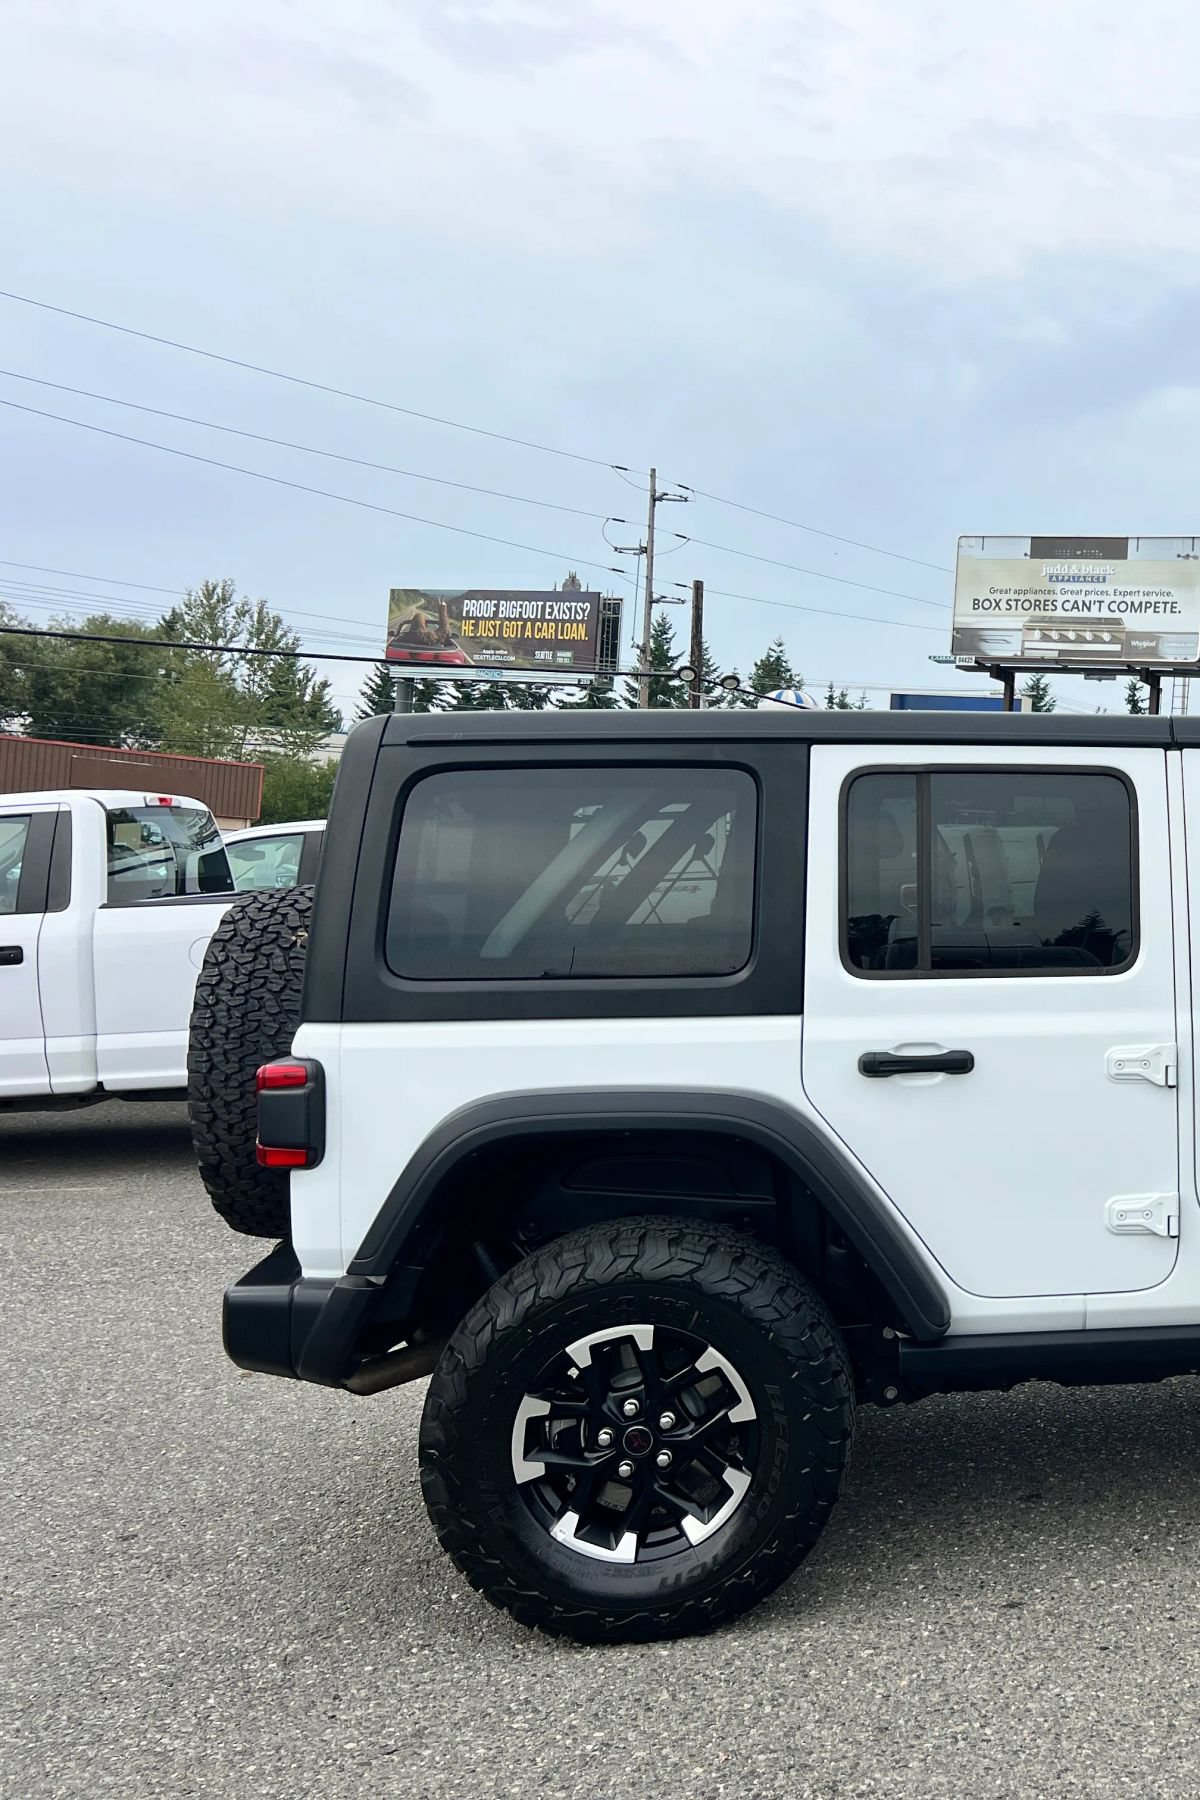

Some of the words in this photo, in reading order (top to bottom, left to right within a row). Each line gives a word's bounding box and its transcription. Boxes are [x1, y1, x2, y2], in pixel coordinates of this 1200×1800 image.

[1041, 564, 1069, 577] judd
[1070, 564, 1081, 575] &
[1081, 564, 1116, 576] black
[989, 587, 1012, 595] Great
[1013, 587, 1058, 597] appliances.
[1060, 588, 1083, 596] Great
[1084, 588, 1111, 598] prices.
[1113, 589, 1140, 599] Expert
[1142, 589, 1174, 598] service.
[462, 599, 498, 618] PROOF
[499, 600, 544, 619] BIGFOOT
[545, 602, 591, 620] EXISTS?
[972, 598, 1003, 611] BOX
[1005, 599, 1058, 612] STORES
[1061, 600, 1104, 613] CAN'T
[1107, 600, 1182, 615] COMPETE.
[461, 620, 476, 637] HE
[476, 620, 502, 637] JUST
[502, 621, 523, 638] GOT
[524, 622, 532, 639] A
[534, 622, 556, 640] CAR
[558, 622, 589, 641] LOAN.
[1130, 639, 1157, 648] Whirlpool
[534, 650, 554, 660] SEATTLE
[477, 670, 502, 678] PACIFIC
